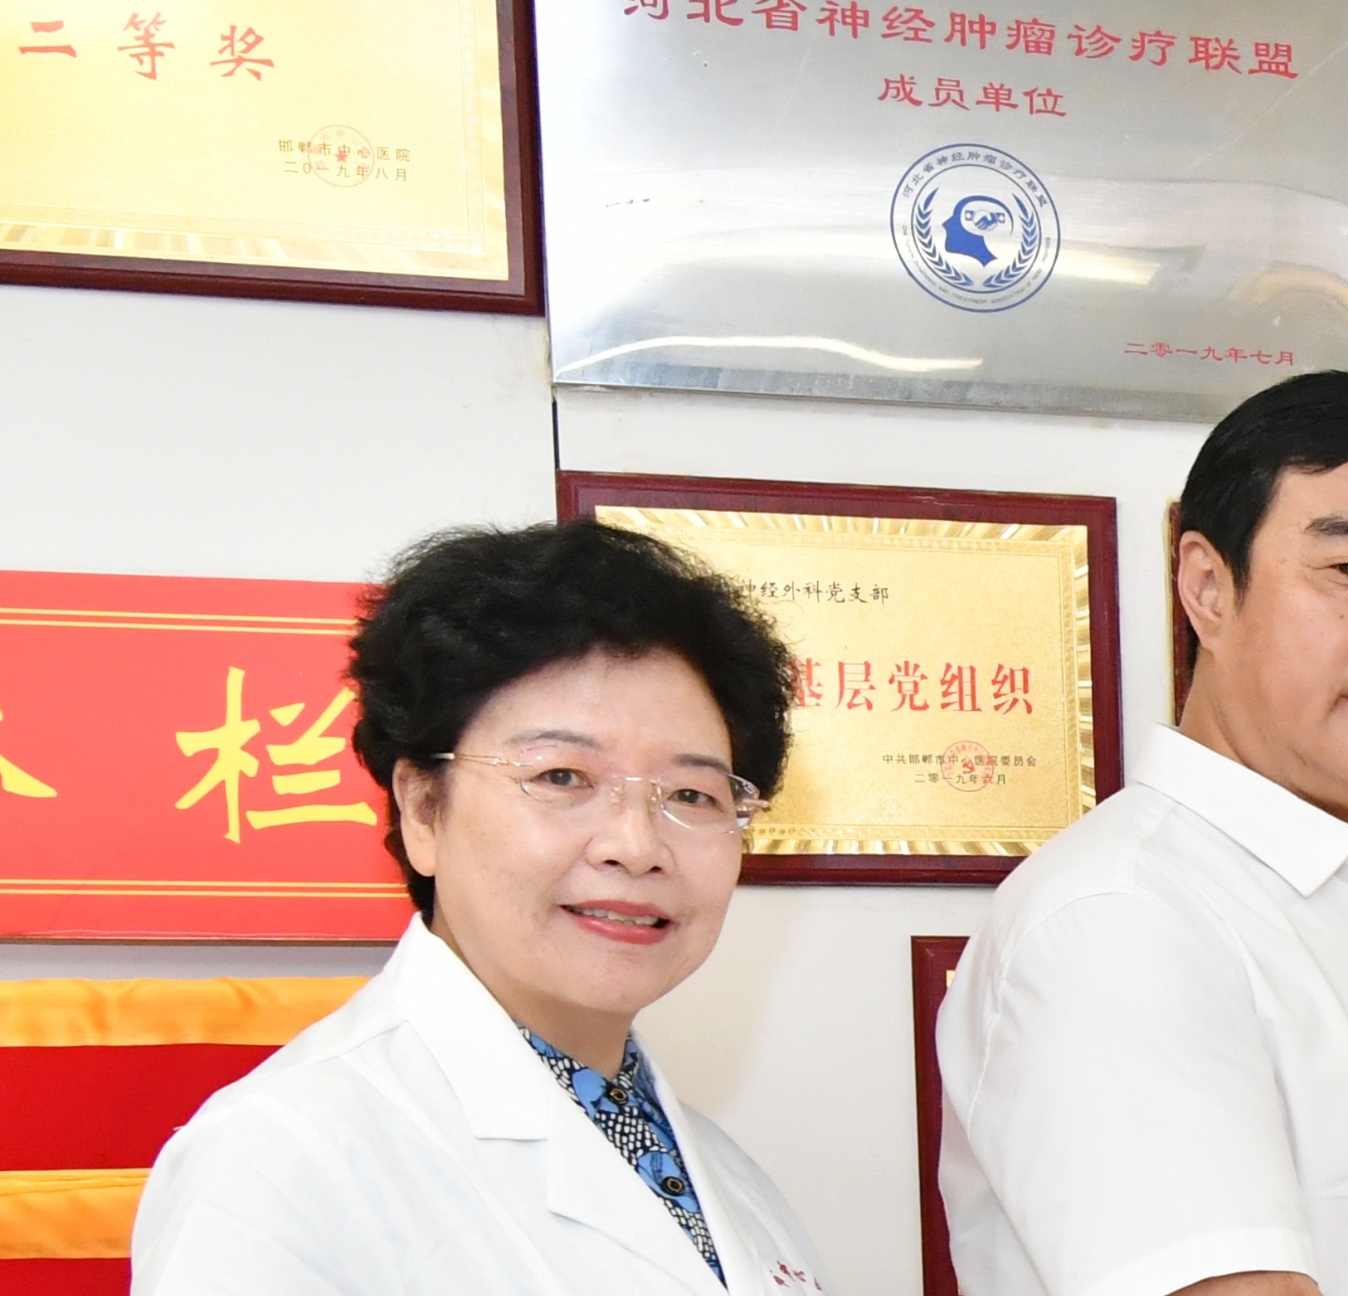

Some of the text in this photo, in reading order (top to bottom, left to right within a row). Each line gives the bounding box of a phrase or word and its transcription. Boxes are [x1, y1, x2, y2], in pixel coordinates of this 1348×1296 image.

[18, 12, 275, 82] 二等奖
[624, 0, 1300, 80] 河北省神经肿瘤诊疗联盟
[878, 75, 1068, 118] 成员单位
[279, 139, 411, 162] 邯郸市中心医院
[1125, 342, 1297, 367] 二零一九年七月
